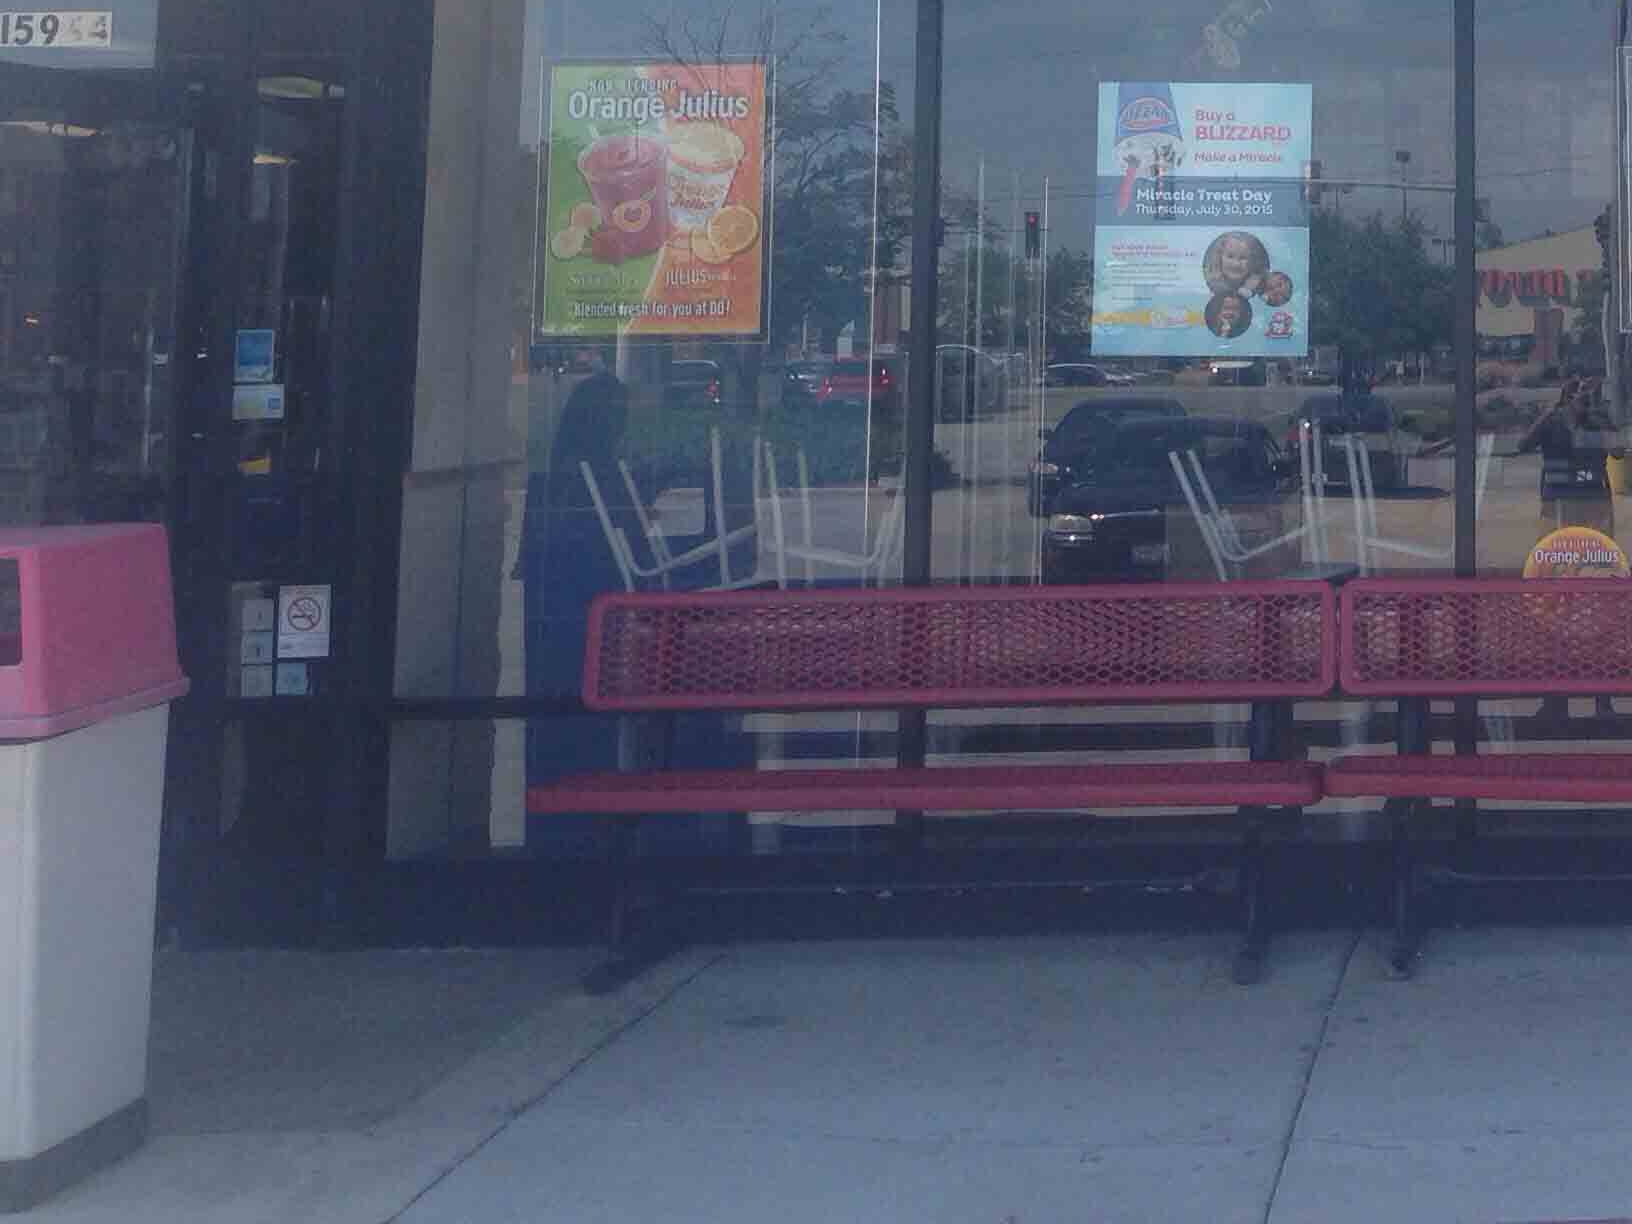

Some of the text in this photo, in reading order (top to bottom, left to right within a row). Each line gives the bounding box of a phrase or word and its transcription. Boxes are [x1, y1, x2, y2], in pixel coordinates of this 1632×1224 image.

[568, 88, 750, 125] Orange Julius
[1194, 109, 1236, 122] Buy a
[1194, 125, 1291, 142] BLIZZARD
[1194, 151, 1226, 163] Make
[1227, 154, 1237, 163] a
[1136, 188, 1273, 205] Miracle Treat Day
[1136, 203, 1273, 218] Thursday, July 30, 2015
[666, 269, 706, 287] JULIUS
[574, 301, 618, 318] Blended
[618, 301, 649, 317] fresh
[652, 301, 668, 316] for
[671, 304, 693, 318] you
[695, 302, 709, 315] at
[1534, 548, 1618, 566] Orange Julius
